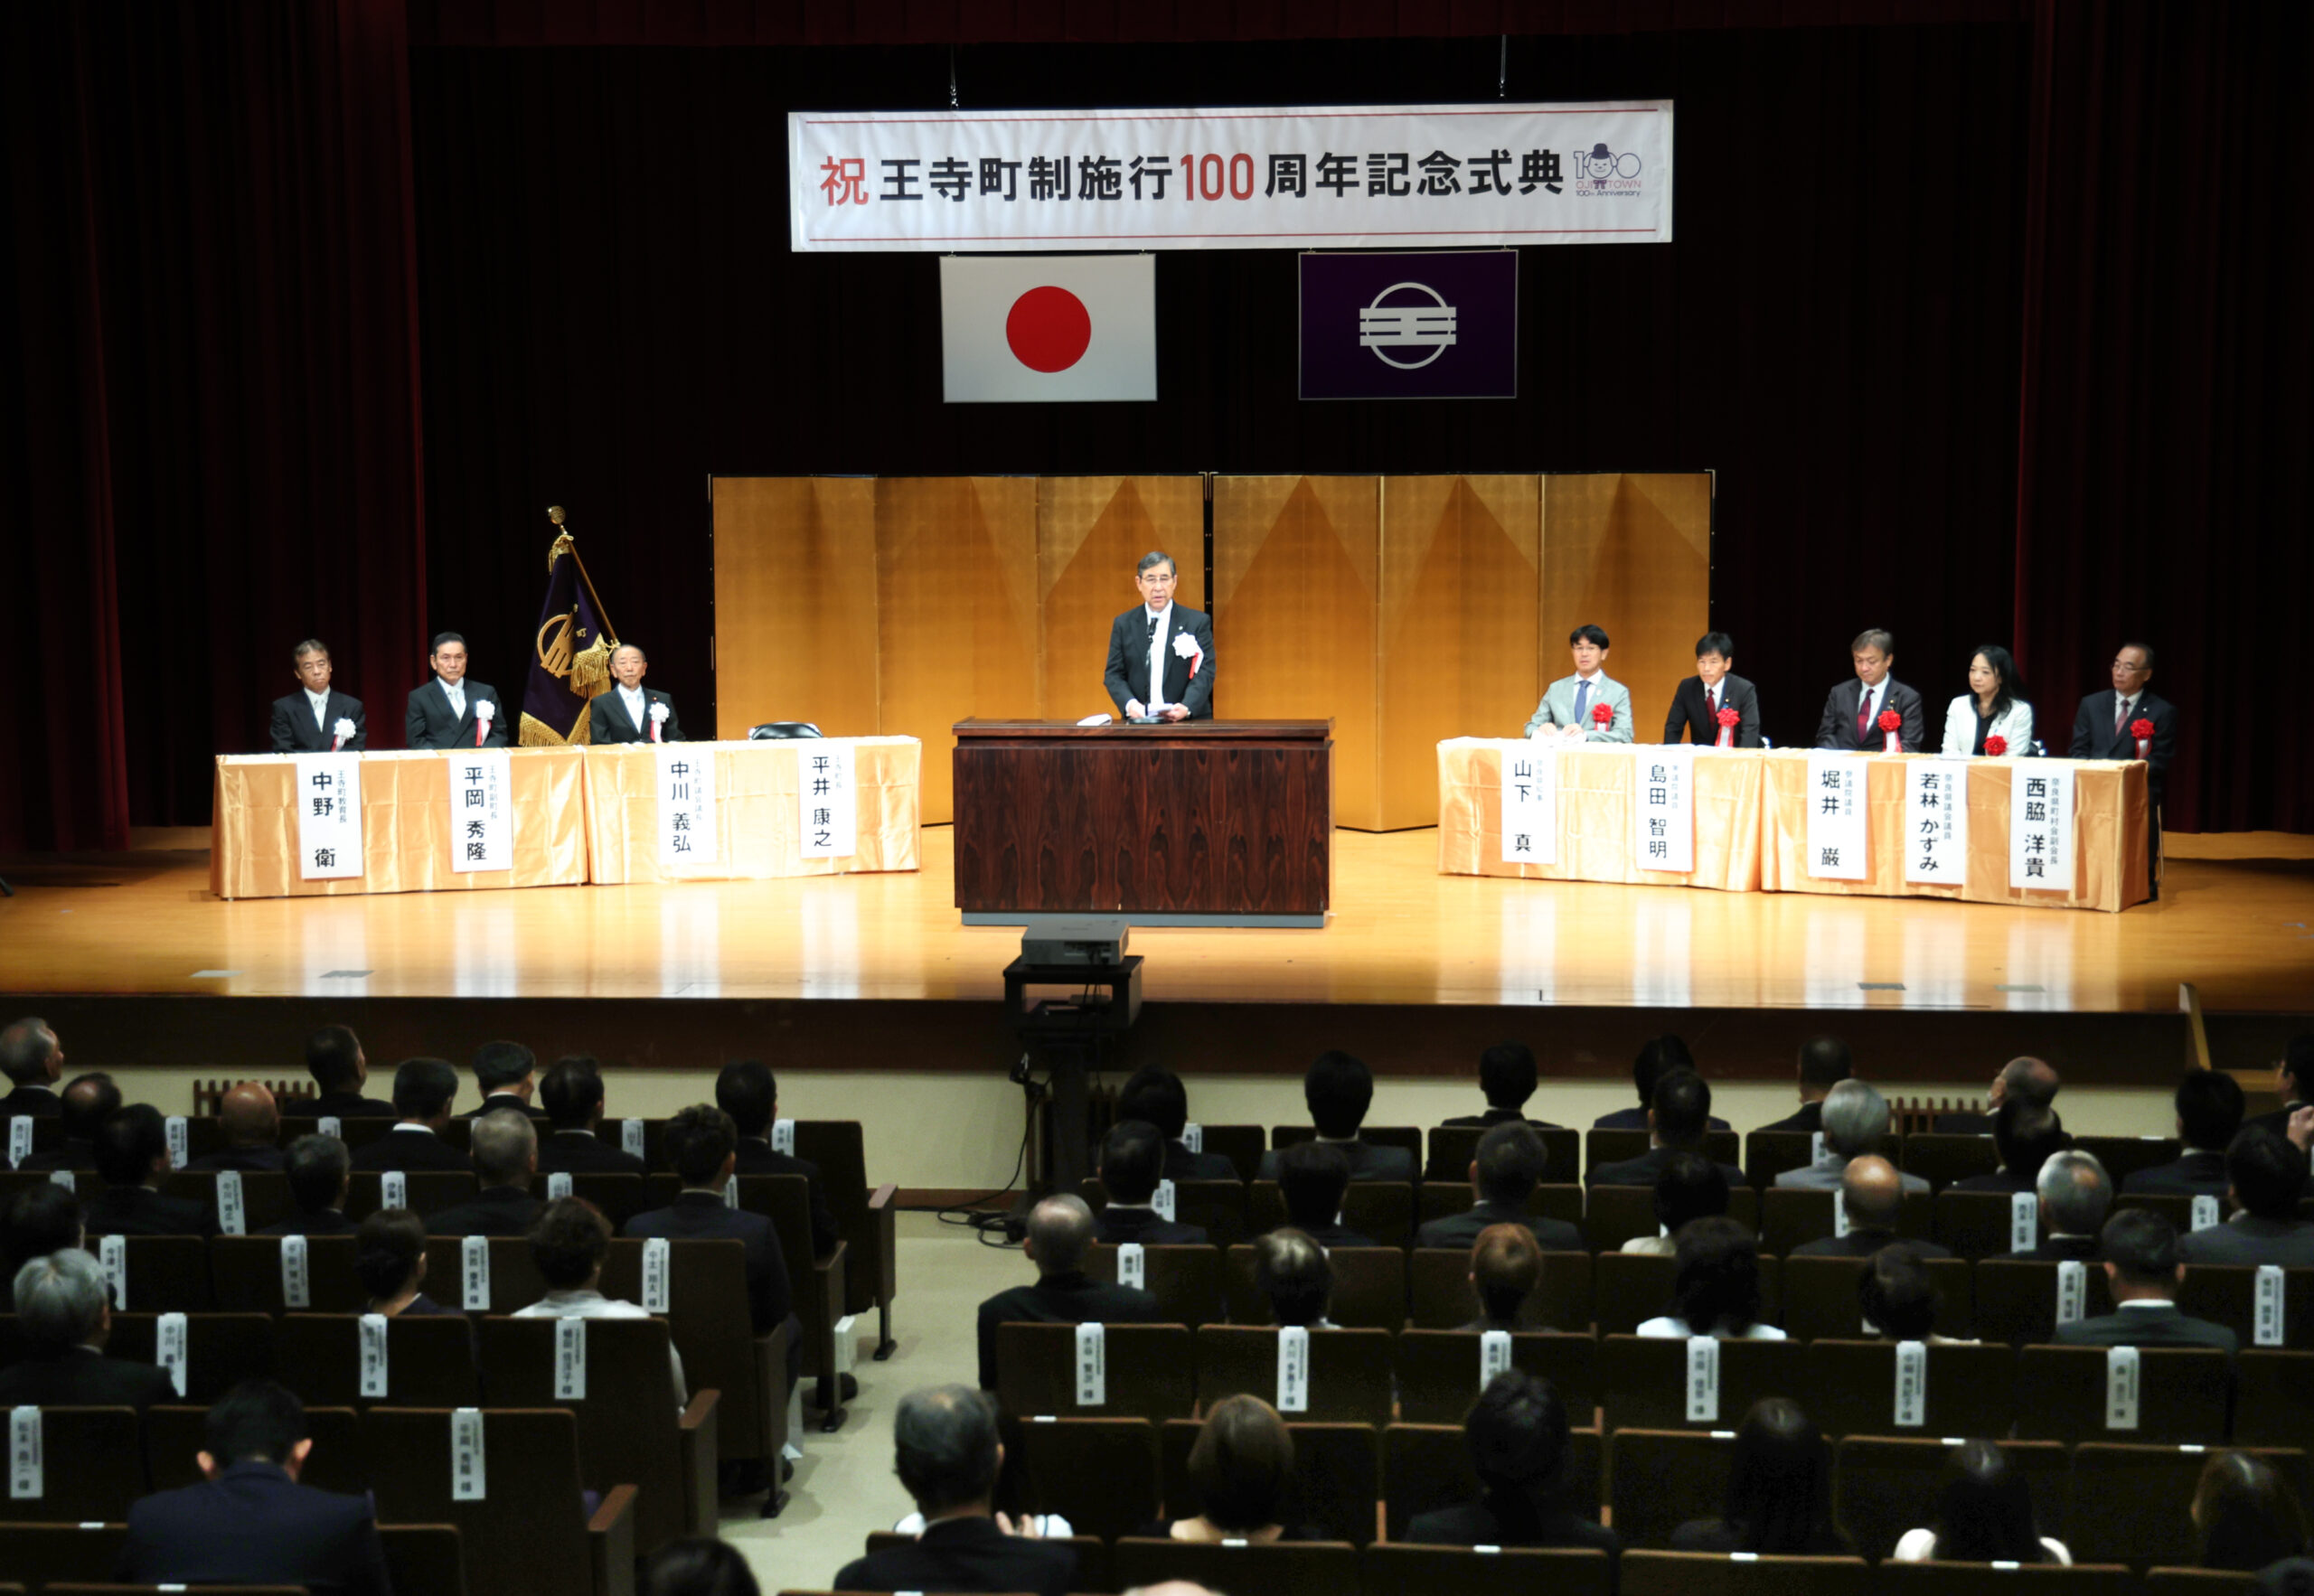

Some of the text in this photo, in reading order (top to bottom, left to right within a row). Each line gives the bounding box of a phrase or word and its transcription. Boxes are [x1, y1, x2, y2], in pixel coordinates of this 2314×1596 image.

[1608, 180, 1641, 189] TOWN
[465, 766, 486, 860] 平岡秀隆
[671, 760, 691, 852] 中川義弘
[813, 756, 832, 847] 平井康之
[1650, 765, 1667, 859] 島田智明
[2025, 777, 2046, 878] 西脇洋貴
